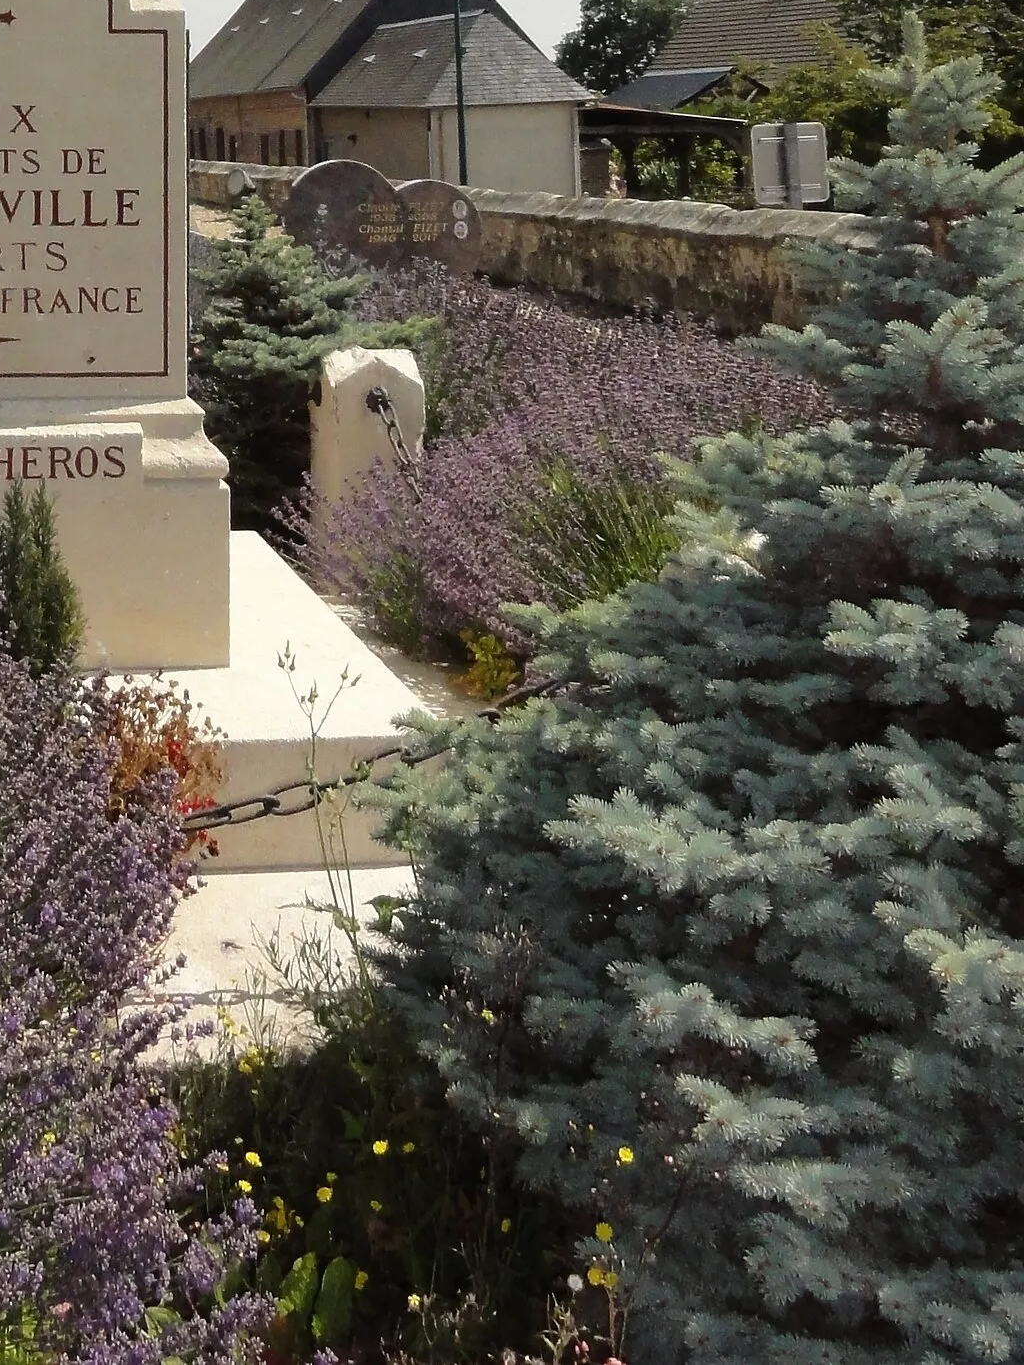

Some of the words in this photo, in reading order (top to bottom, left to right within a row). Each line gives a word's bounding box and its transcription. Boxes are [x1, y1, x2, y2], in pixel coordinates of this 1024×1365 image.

[62, 149, 106, 174] DE
[358, 223, 404, 234] Chantal
[413, 222, 448, 233] FIZET
[0, 287, 144, 314] FRANCE
